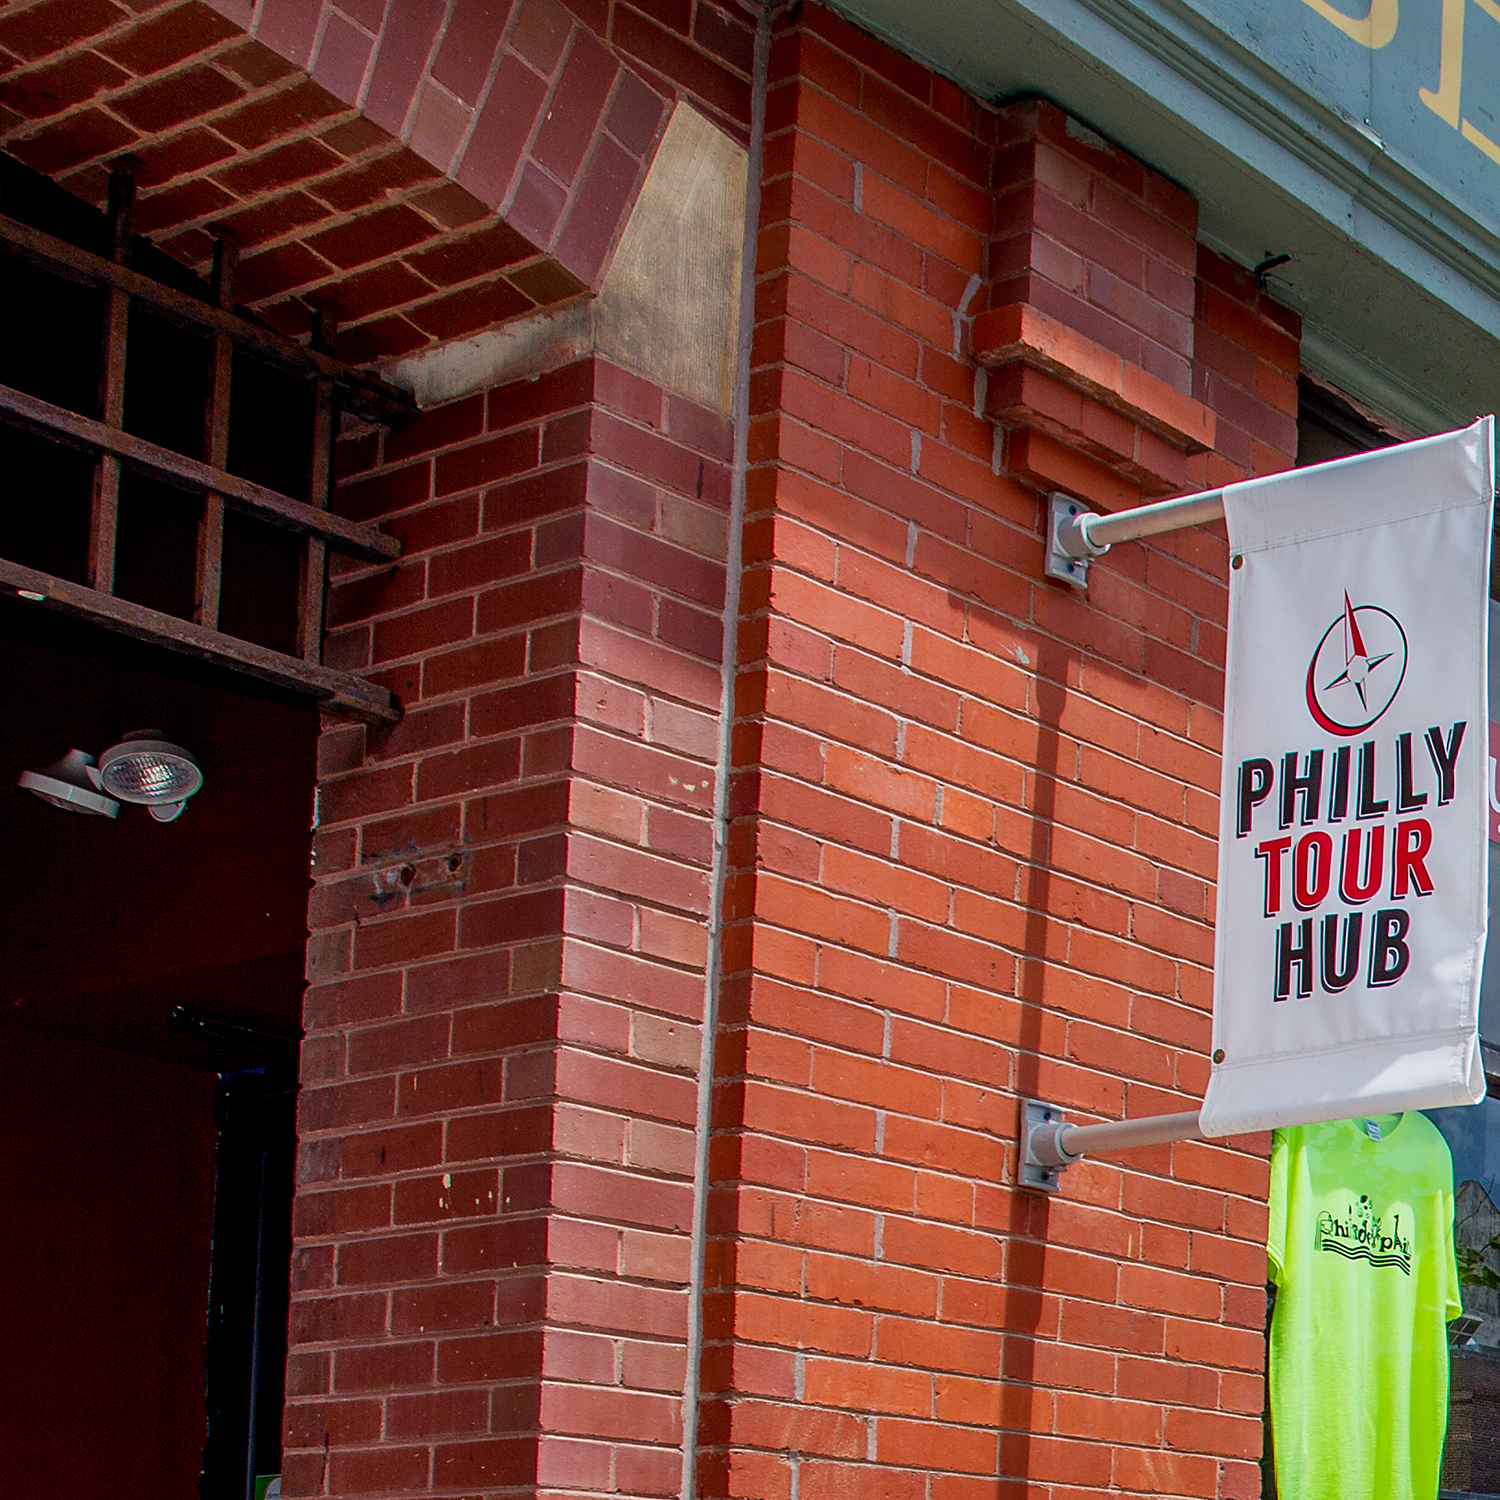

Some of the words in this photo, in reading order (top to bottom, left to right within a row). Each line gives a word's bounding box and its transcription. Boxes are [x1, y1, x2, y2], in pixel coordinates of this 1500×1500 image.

[1236, 721, 1467, 838] PHILLY
[1255, 817, 1434, 918] TOUR
[1274, 909, 1410, 1002] HUB
